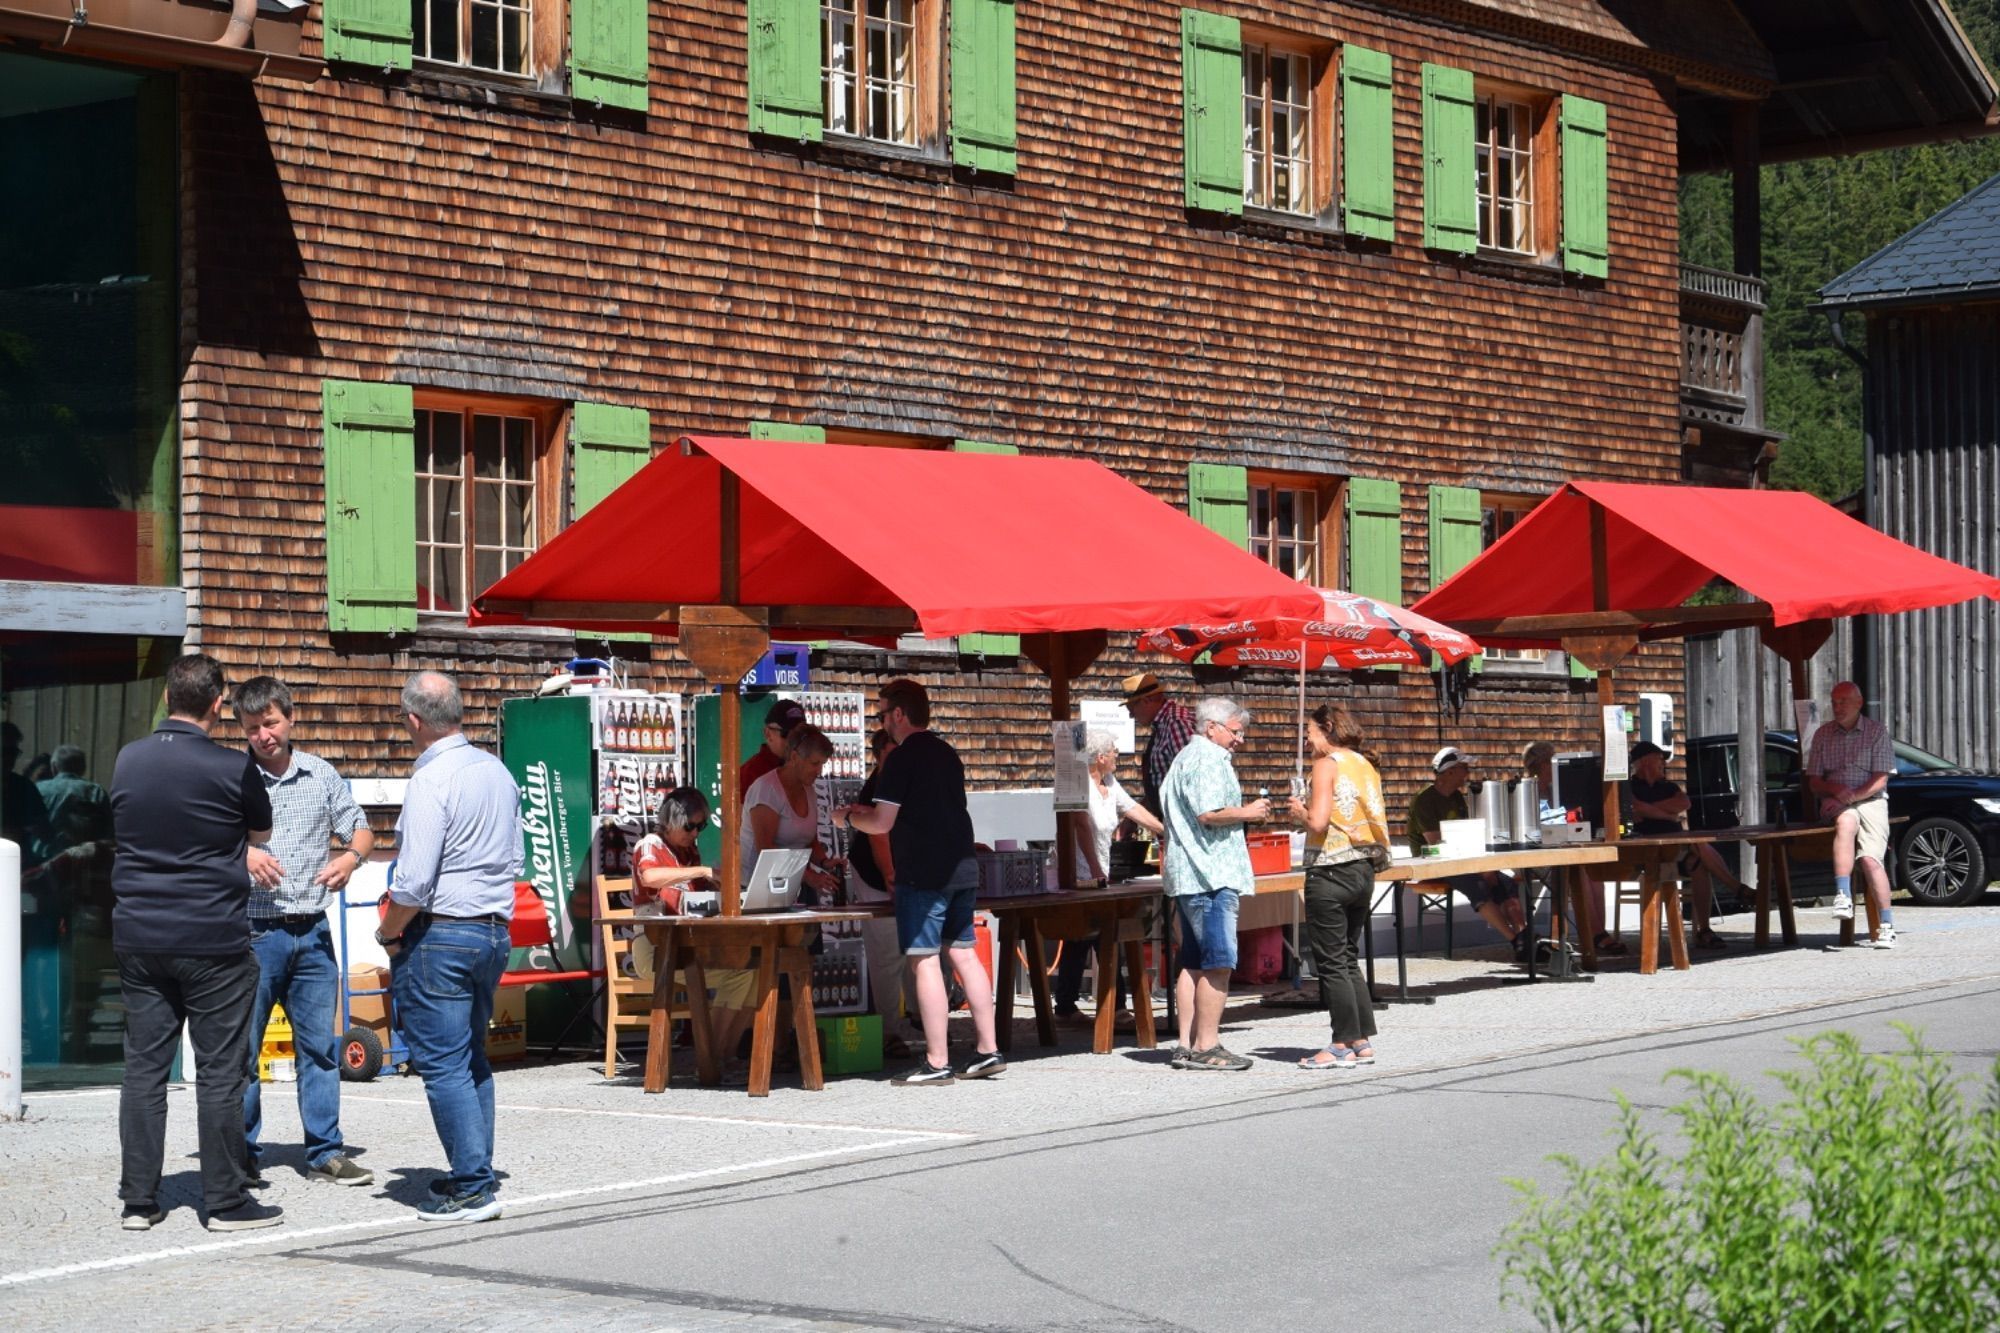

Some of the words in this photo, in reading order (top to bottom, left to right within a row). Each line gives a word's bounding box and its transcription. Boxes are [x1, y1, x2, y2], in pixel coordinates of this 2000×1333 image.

[553, 768, 564, 794] Bier
[556, 795, 574, 870] Vorarlberger
[566, 871, 576, 892] das
